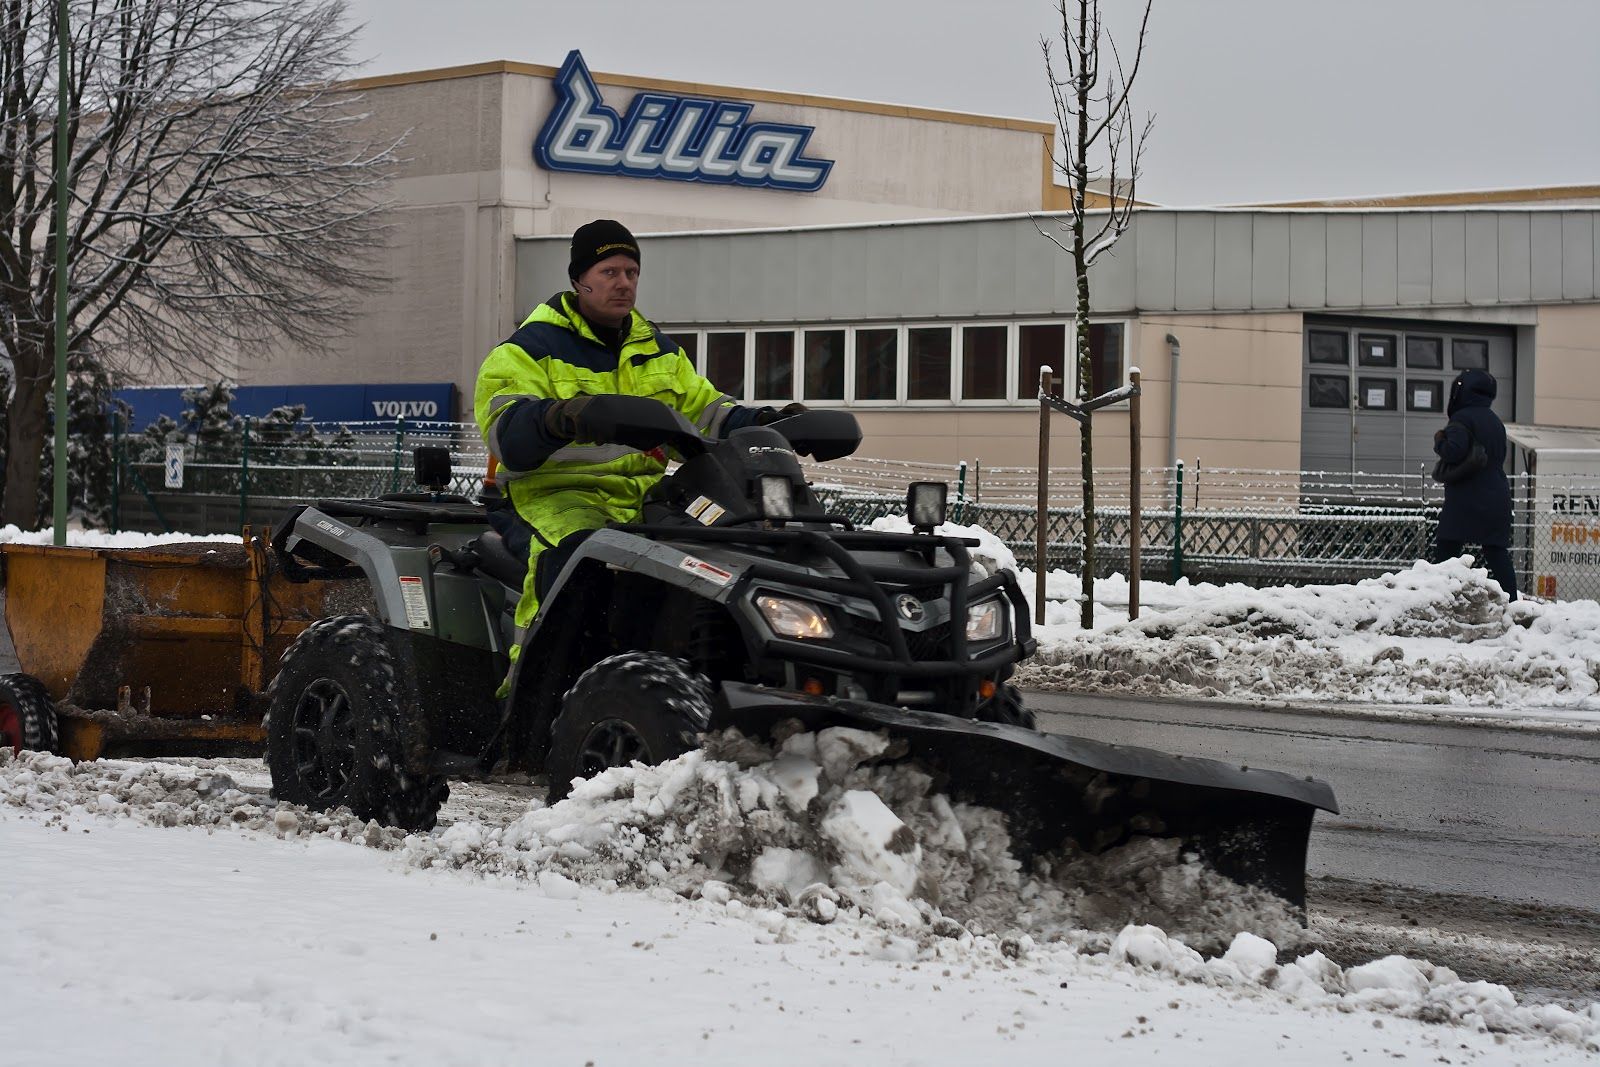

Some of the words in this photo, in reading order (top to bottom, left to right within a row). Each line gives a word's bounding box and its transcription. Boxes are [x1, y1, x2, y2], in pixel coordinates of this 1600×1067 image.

[540, 54, 832, 190] bilia
[371, 401, 438, 417] VOLVO
[1550, 551, 1567, 564] DIN
